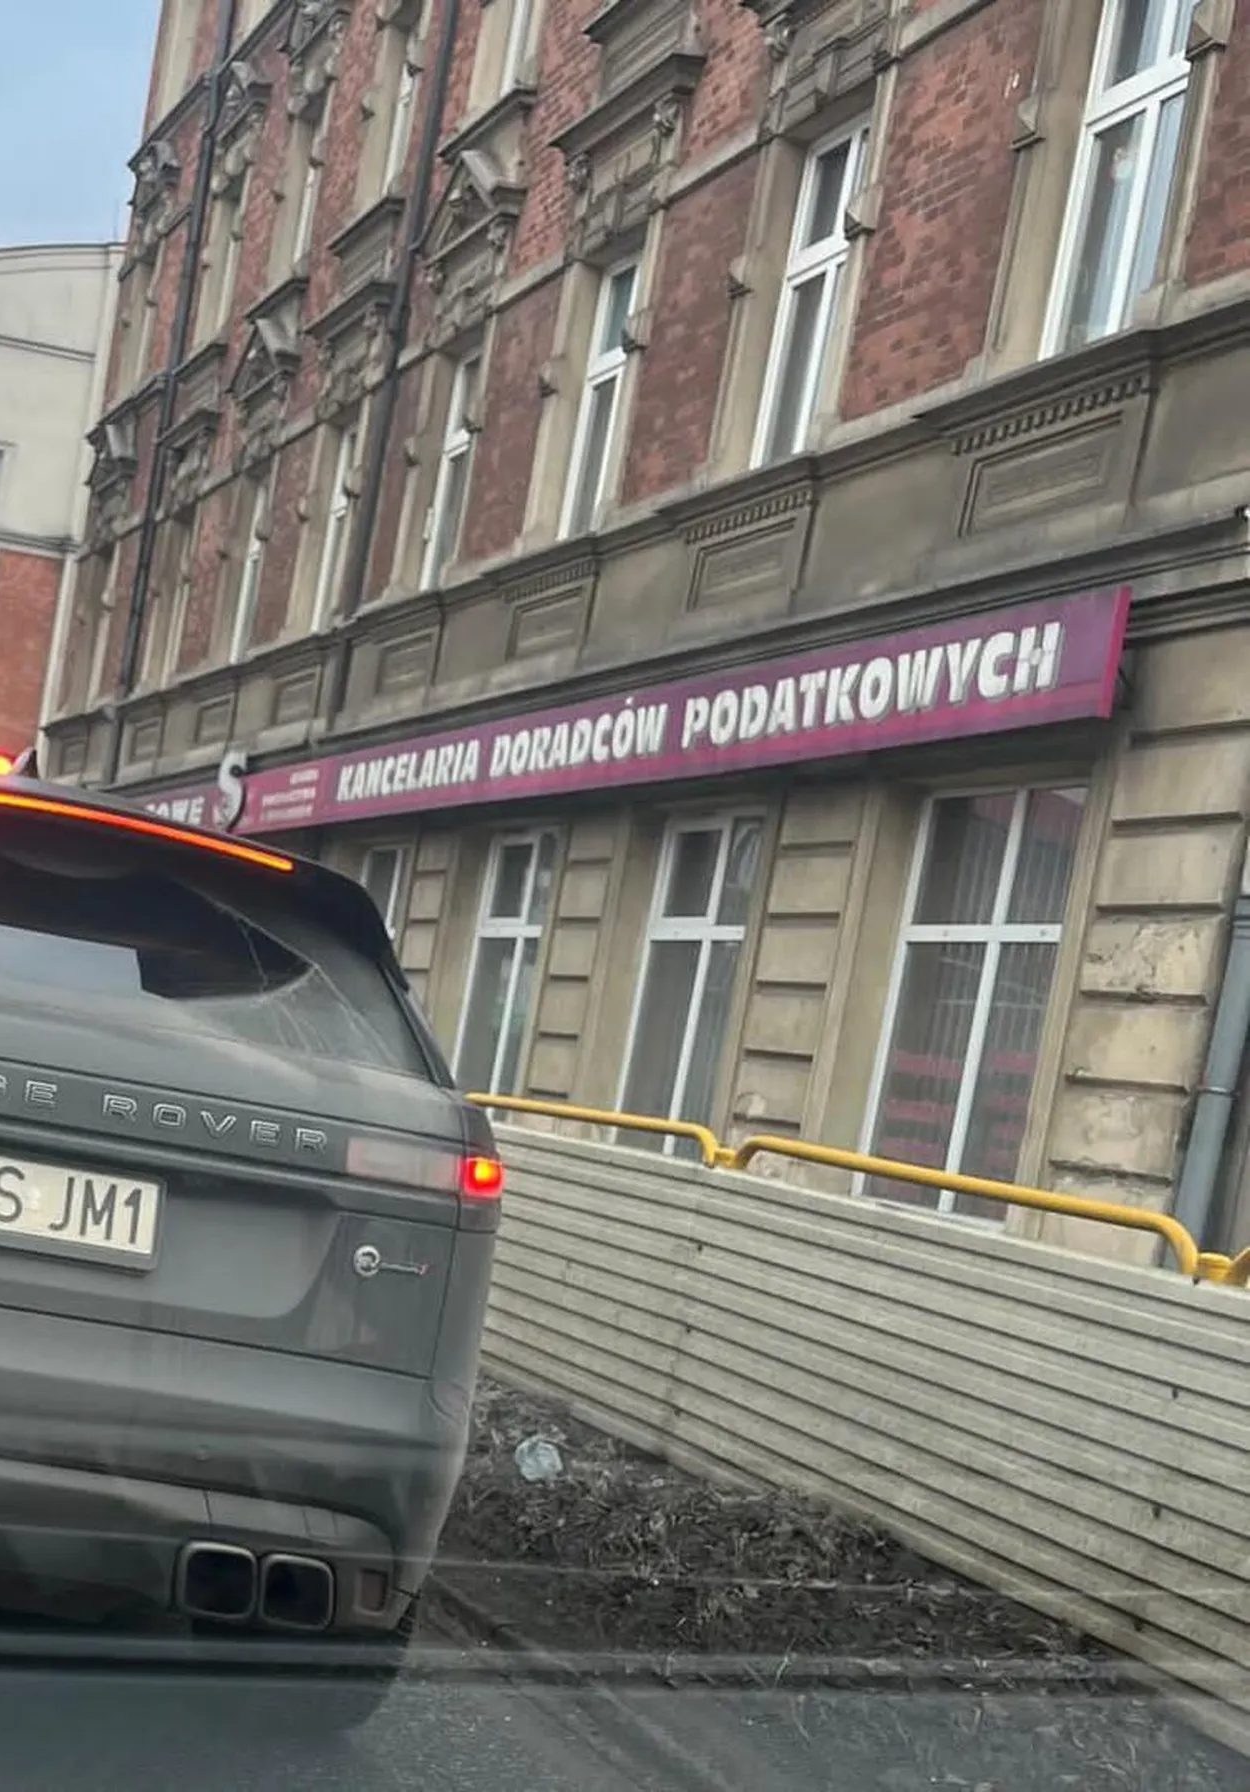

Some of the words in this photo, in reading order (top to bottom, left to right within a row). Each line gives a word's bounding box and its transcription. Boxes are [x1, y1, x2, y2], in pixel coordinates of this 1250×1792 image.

[336, 738, 481, 803] KANCELARIA
[489, 697, 669, 780] DORADCÓW
[681, 621, 1063, 750] PODATKOWYCH
[103, 1093, 328, 1153] ROVER
[48, 1176, 143, 1245] JM1
